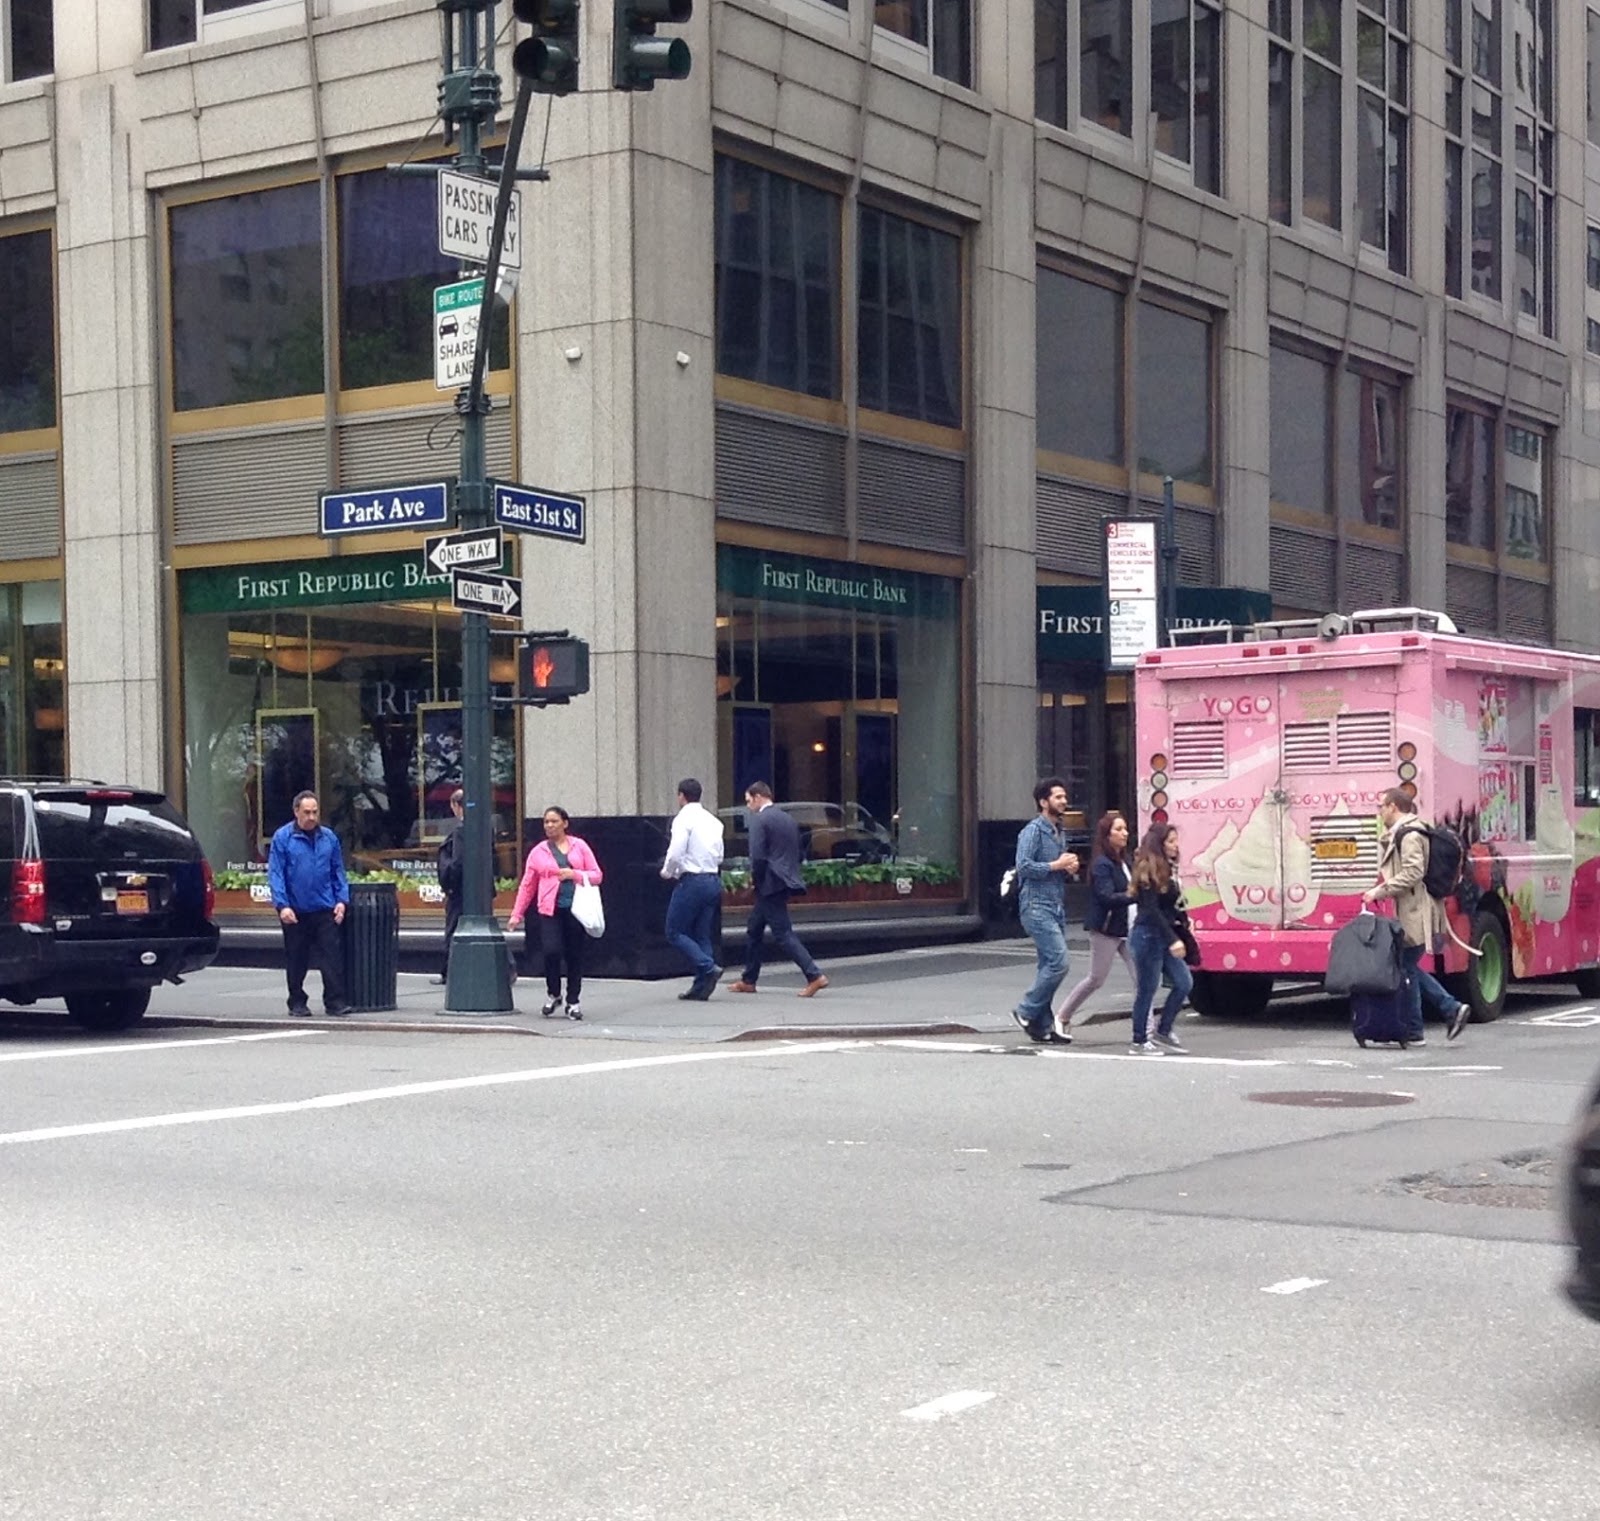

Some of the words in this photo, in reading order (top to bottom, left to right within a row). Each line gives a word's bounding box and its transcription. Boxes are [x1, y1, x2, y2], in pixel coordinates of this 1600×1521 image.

[446, 183, 516, 222] PASSENR
[446, 215, 477, 244] CARS
[486, 225, 516, 253] OLY
[439, 292, 455, 307] BIKE
[458, 285, 483, 303] ROUTE
[440, 340, 475, 360] SHARE
[447, 360, 474, 379] LANE
[342, 499, 385, 524] Park
[388, 497, 425, 519] Ave
[502, 495, 531, 521] East
[534, 503, 560, 527] 51st
[563, 507, 577, 530] St
[1107, 523, 1117, 538] 3
[439, 546, 462, 563] ONE
[468, 541, 491, 559] WAY
[463, 583, 483, 600] ONE
[491, 588, 512, 604] WAY
[1110, 600, 1119, 615] 6
[1039, 609, 1103, 634] FIRST
[1203, 695, 1272, 717] YOGO
